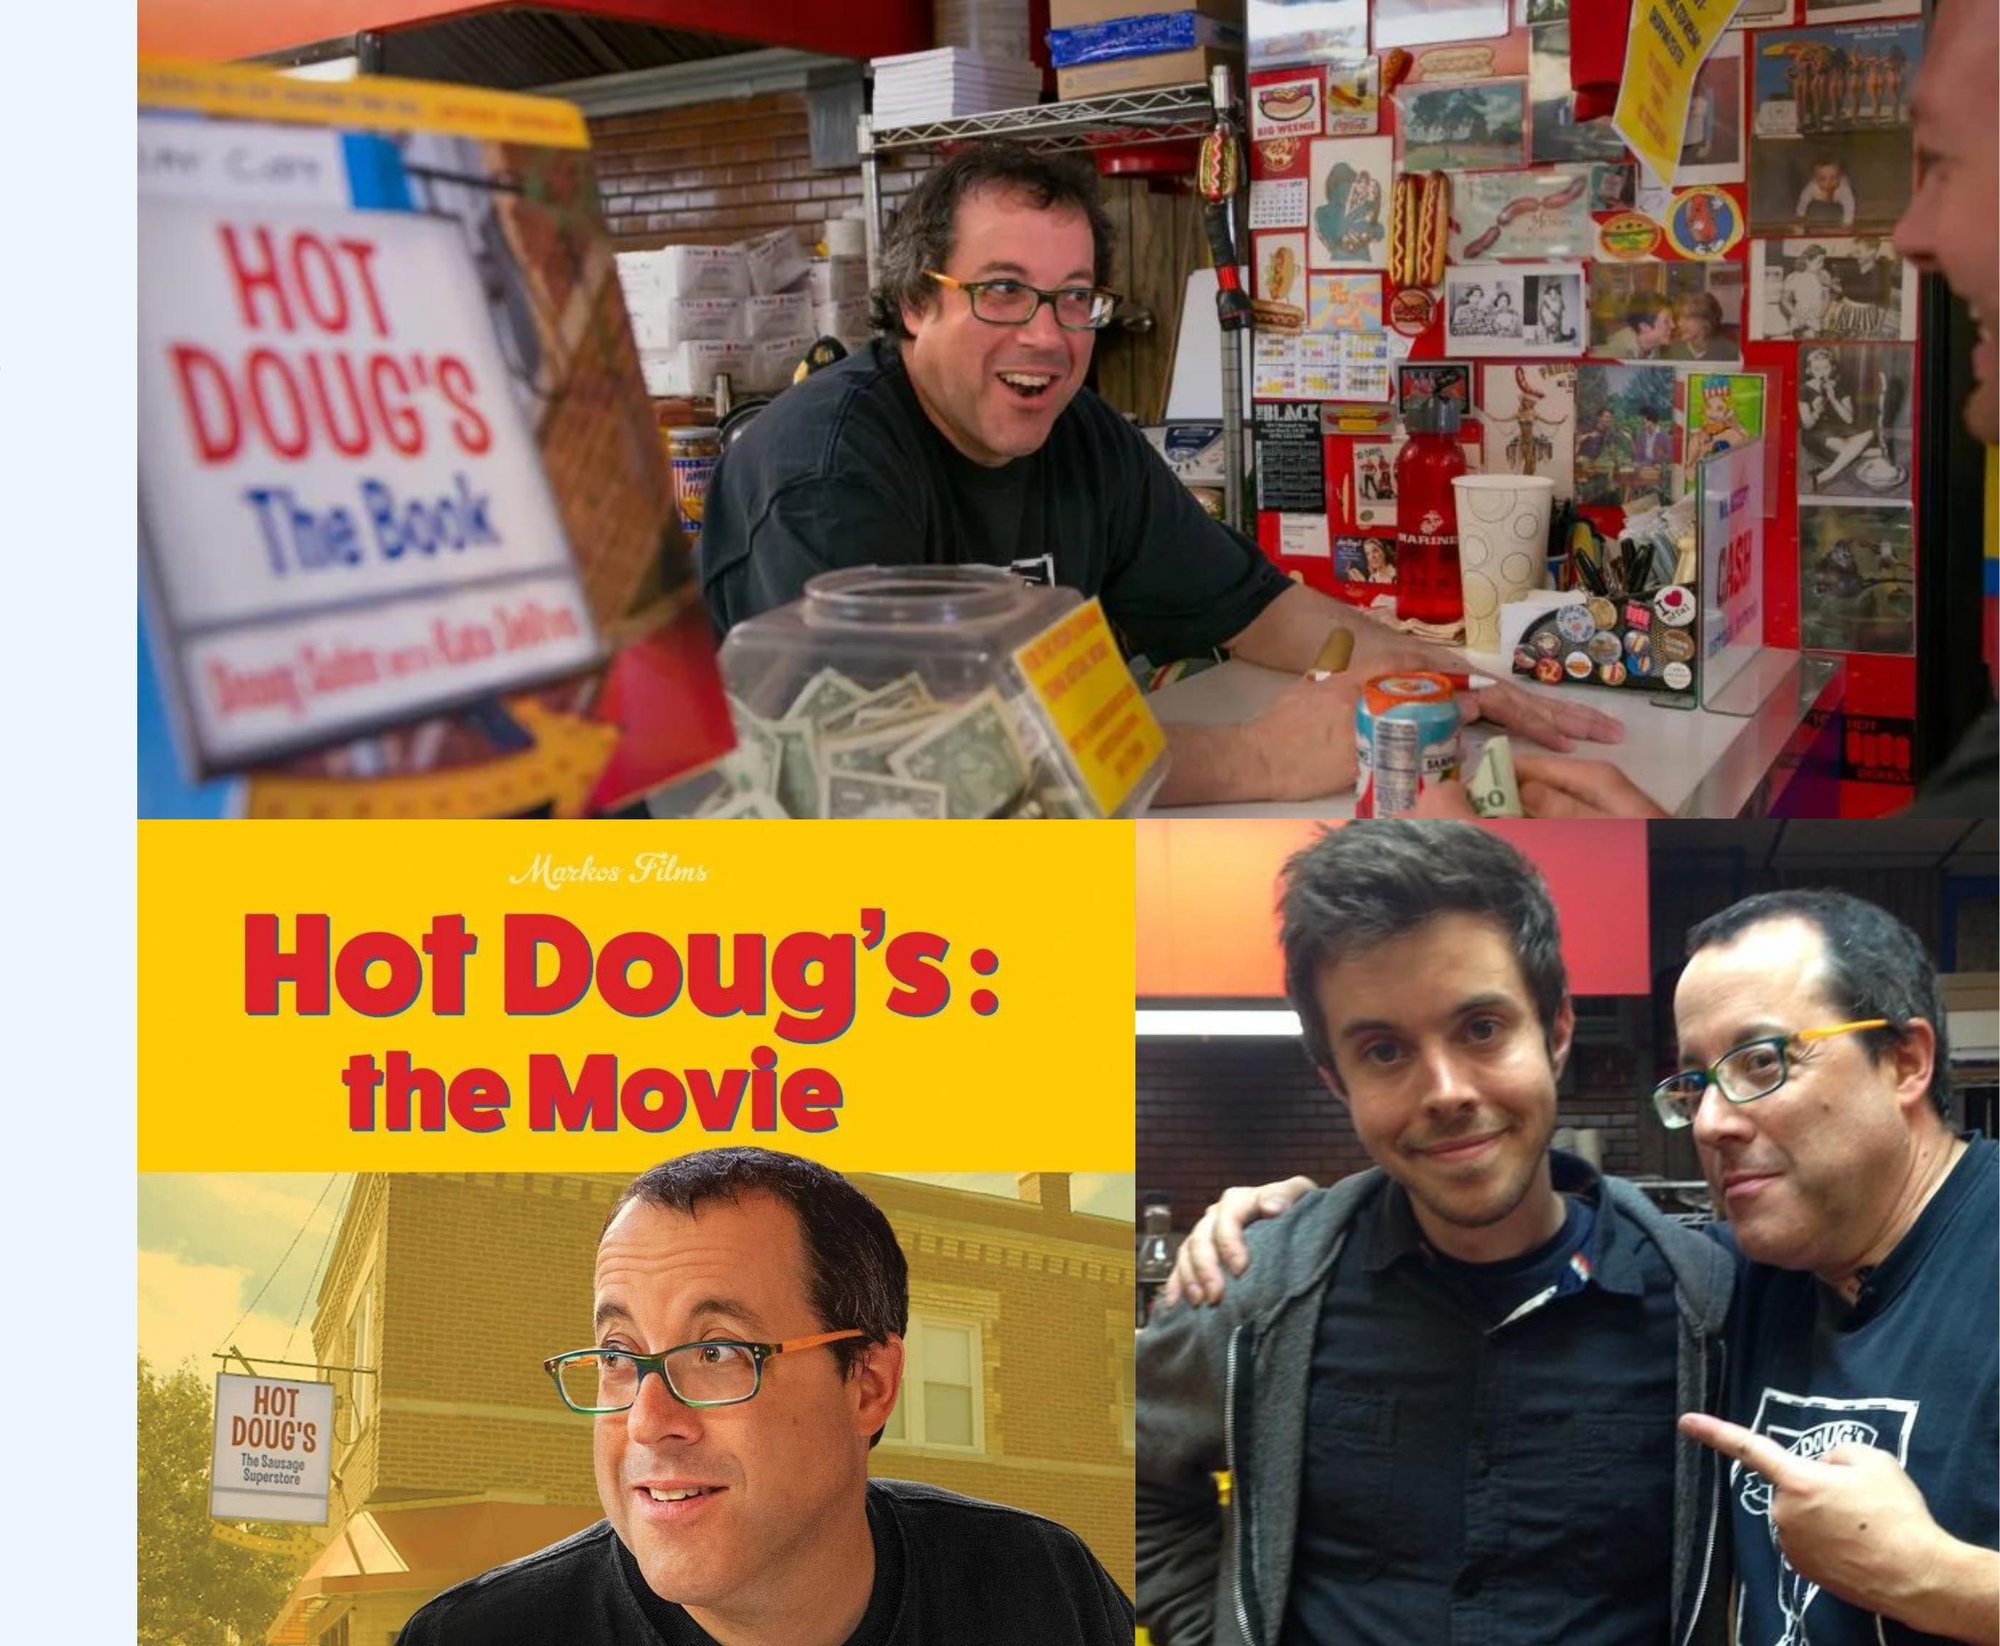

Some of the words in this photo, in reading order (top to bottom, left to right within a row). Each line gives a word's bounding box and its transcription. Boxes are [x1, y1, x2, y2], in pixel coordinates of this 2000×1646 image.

[1257, 126, 1275, 137] BIG
[217, 219, 390, 340] HOT
[169, 341, 496, 465] DOUG'S
[1263, 404, 1320, 421] BLACK
[245, 487, 363, 576] The
[362, 471, 503, 560] Book
[1716, 530, 1753, 608] CASH
[509, 853, 623, 891] Markos
[628, 851, 709, 884] Films
[243, 913, 478, 1017] Hot
[342, 1051, 511, 1133] the
[528, 1045, 844, 1133] Movie
[253, 1385, 300, 1417] HOT
[231, 1416, 317, 1453] DOUG'S
[241, 1452, 260, 1467] The
[261, 1455, 305, 1473] Sausage
[243, 1468, 301, 1485] Superstore
